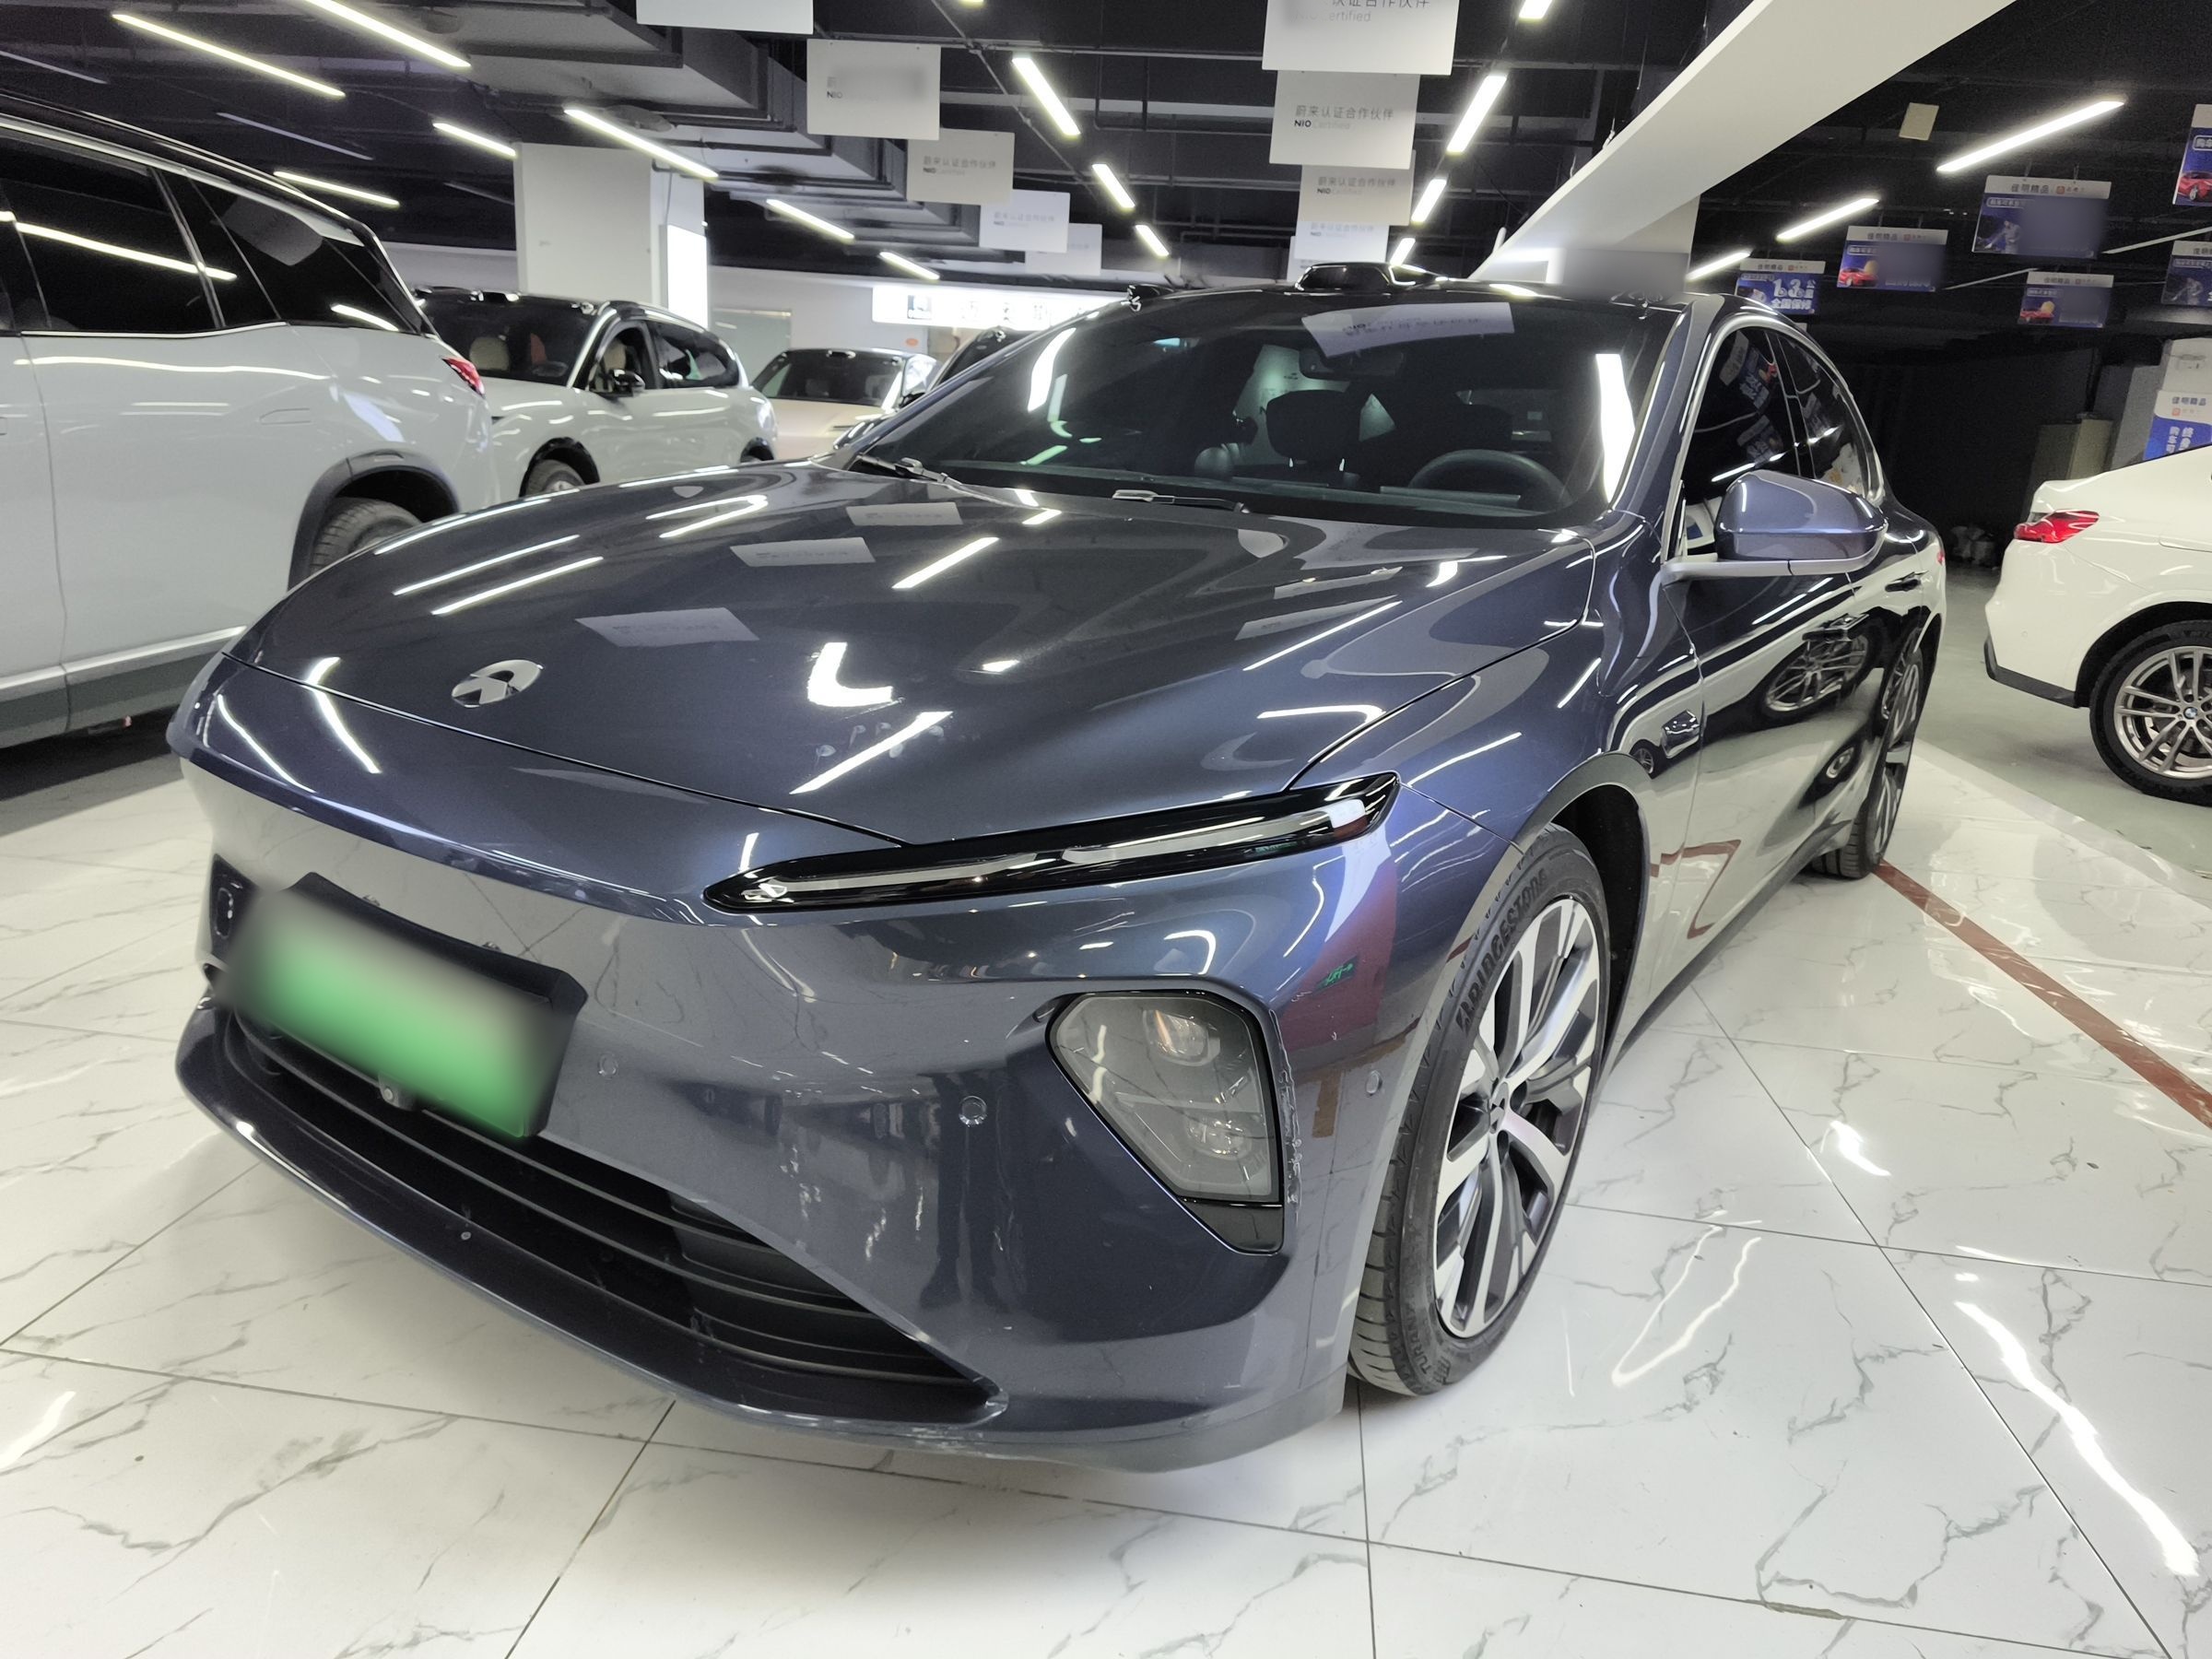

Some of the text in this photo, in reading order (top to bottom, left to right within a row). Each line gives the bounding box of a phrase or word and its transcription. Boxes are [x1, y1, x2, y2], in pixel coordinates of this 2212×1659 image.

[1322, 9, 1371, 22] ertified
[1295, 104, 1394, 121] 蔚来认证合作伙伴
[1294, 119, 1312, 128] NIO
[1455, 867, 1547, 1037] BRIDGESTONE
